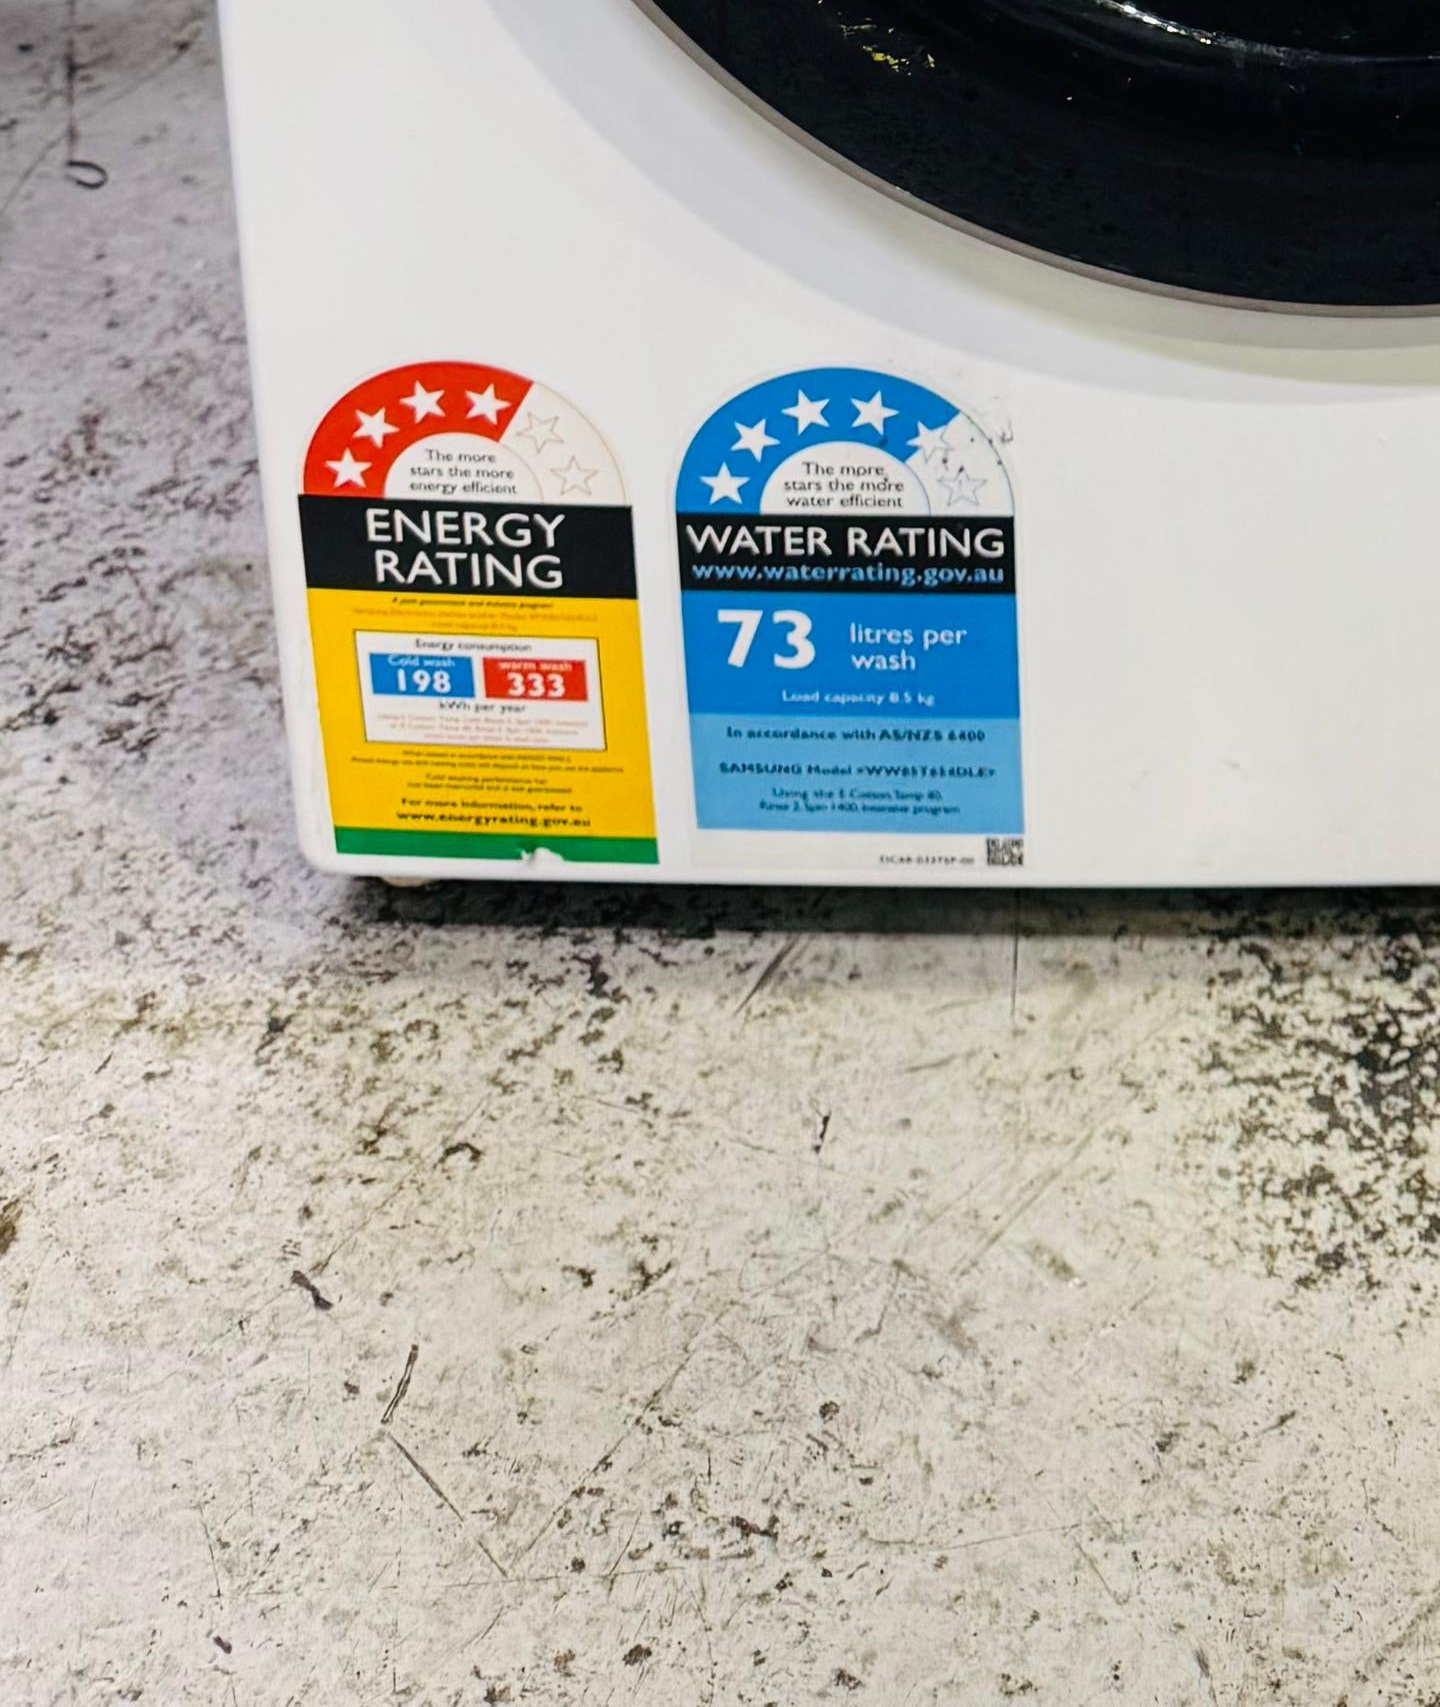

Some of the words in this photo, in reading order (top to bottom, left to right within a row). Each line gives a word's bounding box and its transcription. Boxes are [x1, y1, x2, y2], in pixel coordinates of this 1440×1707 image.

[425, 448, 453, 462] The
[458, 453, 496, 464] more
[410, 466, 443, 477] stars
[448, 467, 471, 478] the
[476, 469, 515, 480] more
[802, 461, 834, 475] The
[840, 465, 884, 477] more
[410, 481, 457, 495] energy
[462, 481, 517, 495] efficient
[783, 480, 822, 492] stars
[828, 478, 855, 492] the
[860, 481, 904, 492] more
[786, 496, 835, 508] water
[840, 493, 904, 508] efficient
[366, 508, 566, 548] ENERGY
[685, 524, 833, 557] WATER
[847, 527, 1005, 559] RATING
[375, 549, 563, 589] RATING
[691, 562, 1005, 588] www.waterrating.gov.au
[717, 609, 816, 669] 73
[850, 622, 914, 645] litres
[923, 628, 968, 651] per
[414, 638, 454, 653] Energy
[388, 655, 420, 667] Cold
[423, 657, 456, 668] wash
[851, 649, 916, 671] wash
[396, 668, 451, 694] 198
[506, 672, 566, 698] 333
[438, 700, 470, 712] kWh
[474, 703, 496, 714] per
[499, 703, 527, 715] year
[726, 726, 742, 738] In
[746, 728, 836, 740] accordance
[841, 729, 876, 741] with
